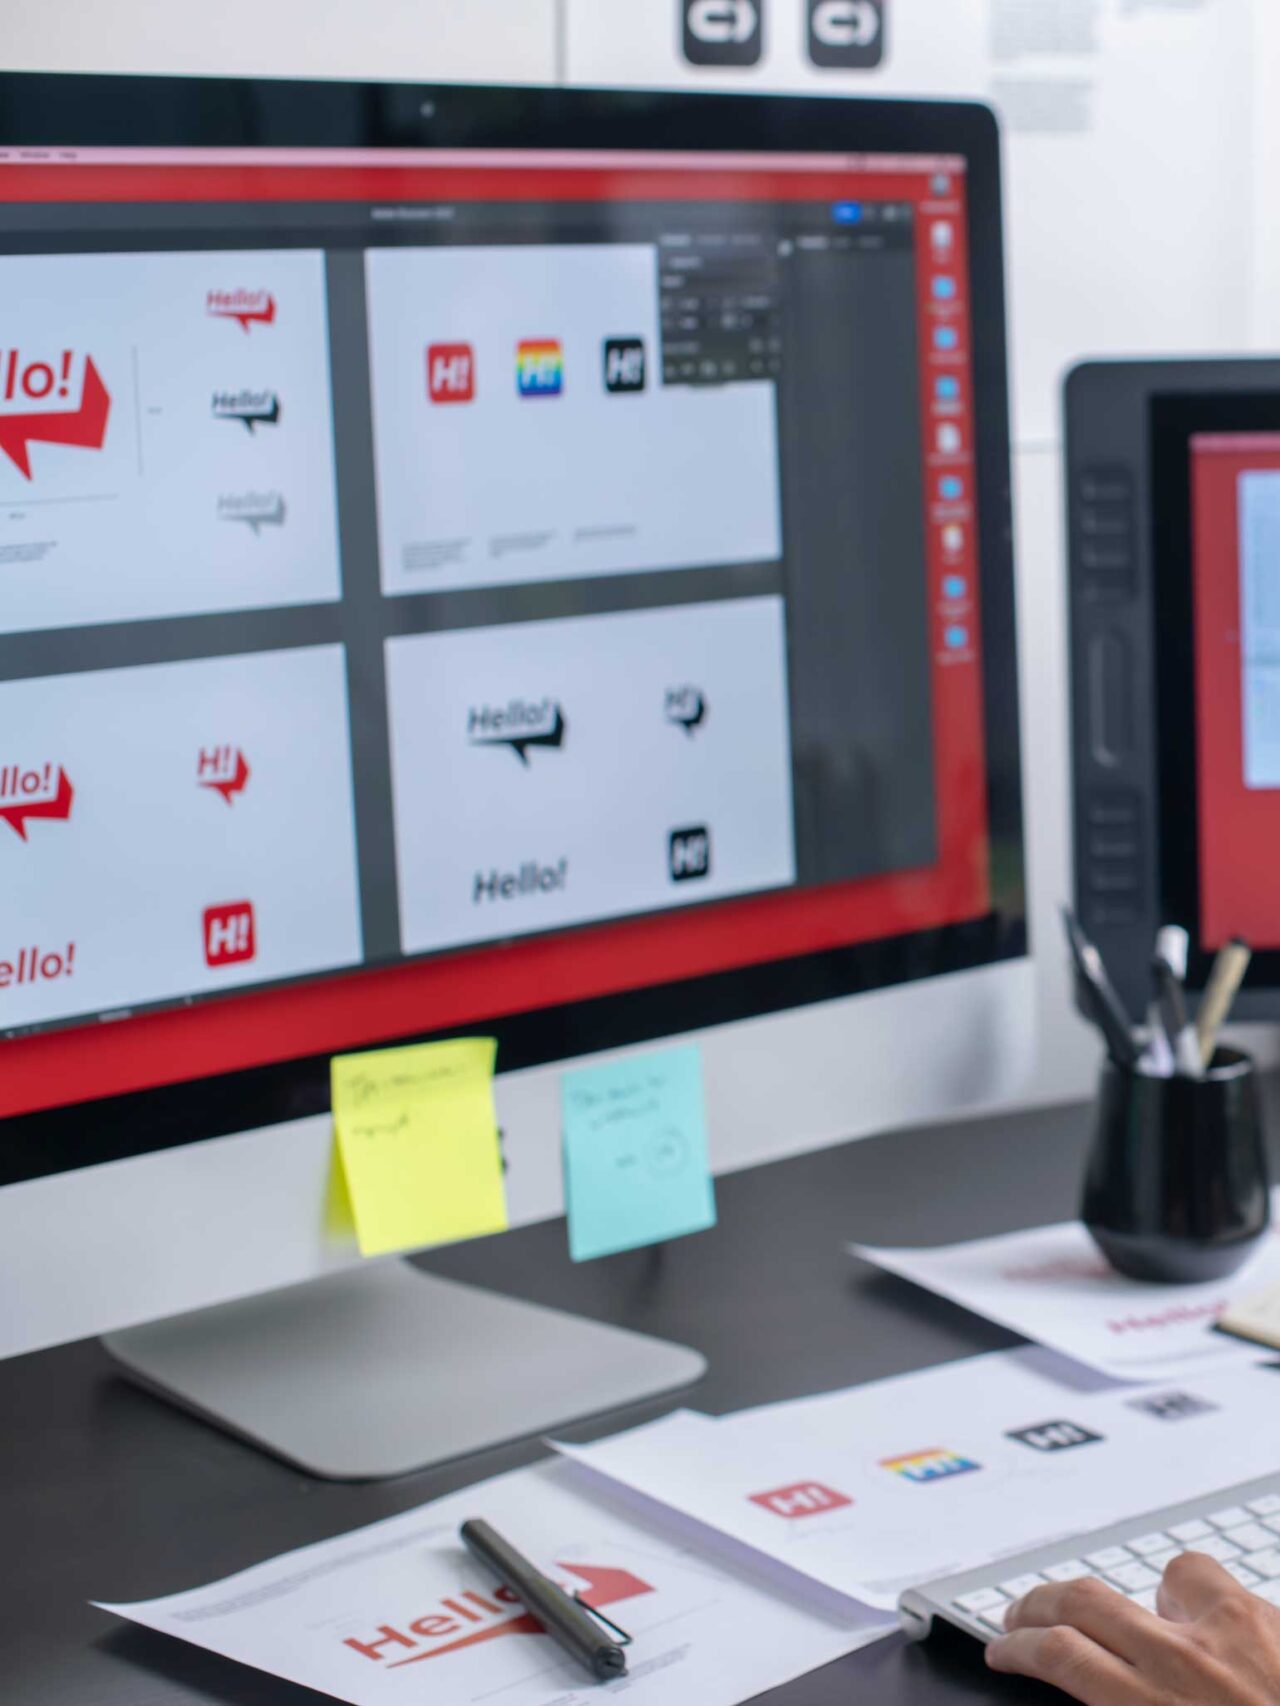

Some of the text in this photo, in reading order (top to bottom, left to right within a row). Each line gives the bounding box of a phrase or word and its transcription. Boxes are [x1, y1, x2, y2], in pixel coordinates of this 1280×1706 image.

[0, 349, 73, 399] lo!
[432, 356, 469, 392] H!
[522, 353, 558, 388] H!
[607, 348, 643, 384] H!
[467, 697, 548, 734] Hello!
[198, 744, 231, 775] H!
[472, 856, 568, 905] Hello!
[208, 912, 249, 957] H!
[769, 1485, 833, 1513] H!
[343, 1582, 523, 1661] Hell
